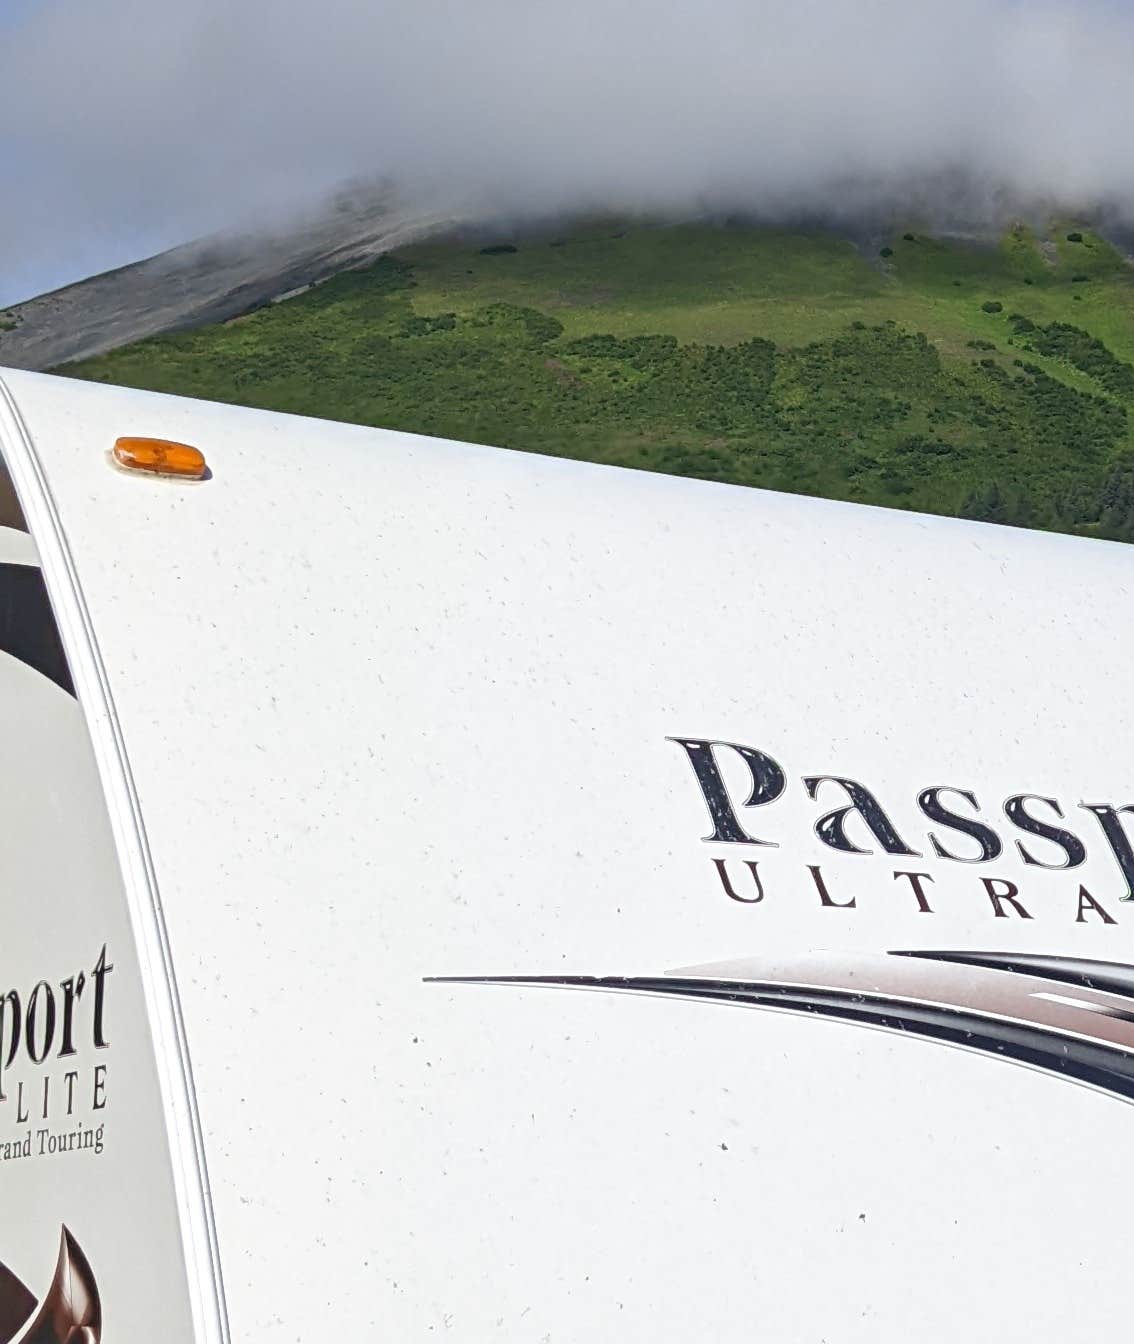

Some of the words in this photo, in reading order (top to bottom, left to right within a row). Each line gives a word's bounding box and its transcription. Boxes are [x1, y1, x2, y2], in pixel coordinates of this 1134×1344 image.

[711, 858, 1118, 925] ULTRA
[16, 1064, 107, 1124] LITE
[37, 1122, 104, 1154] Touring
